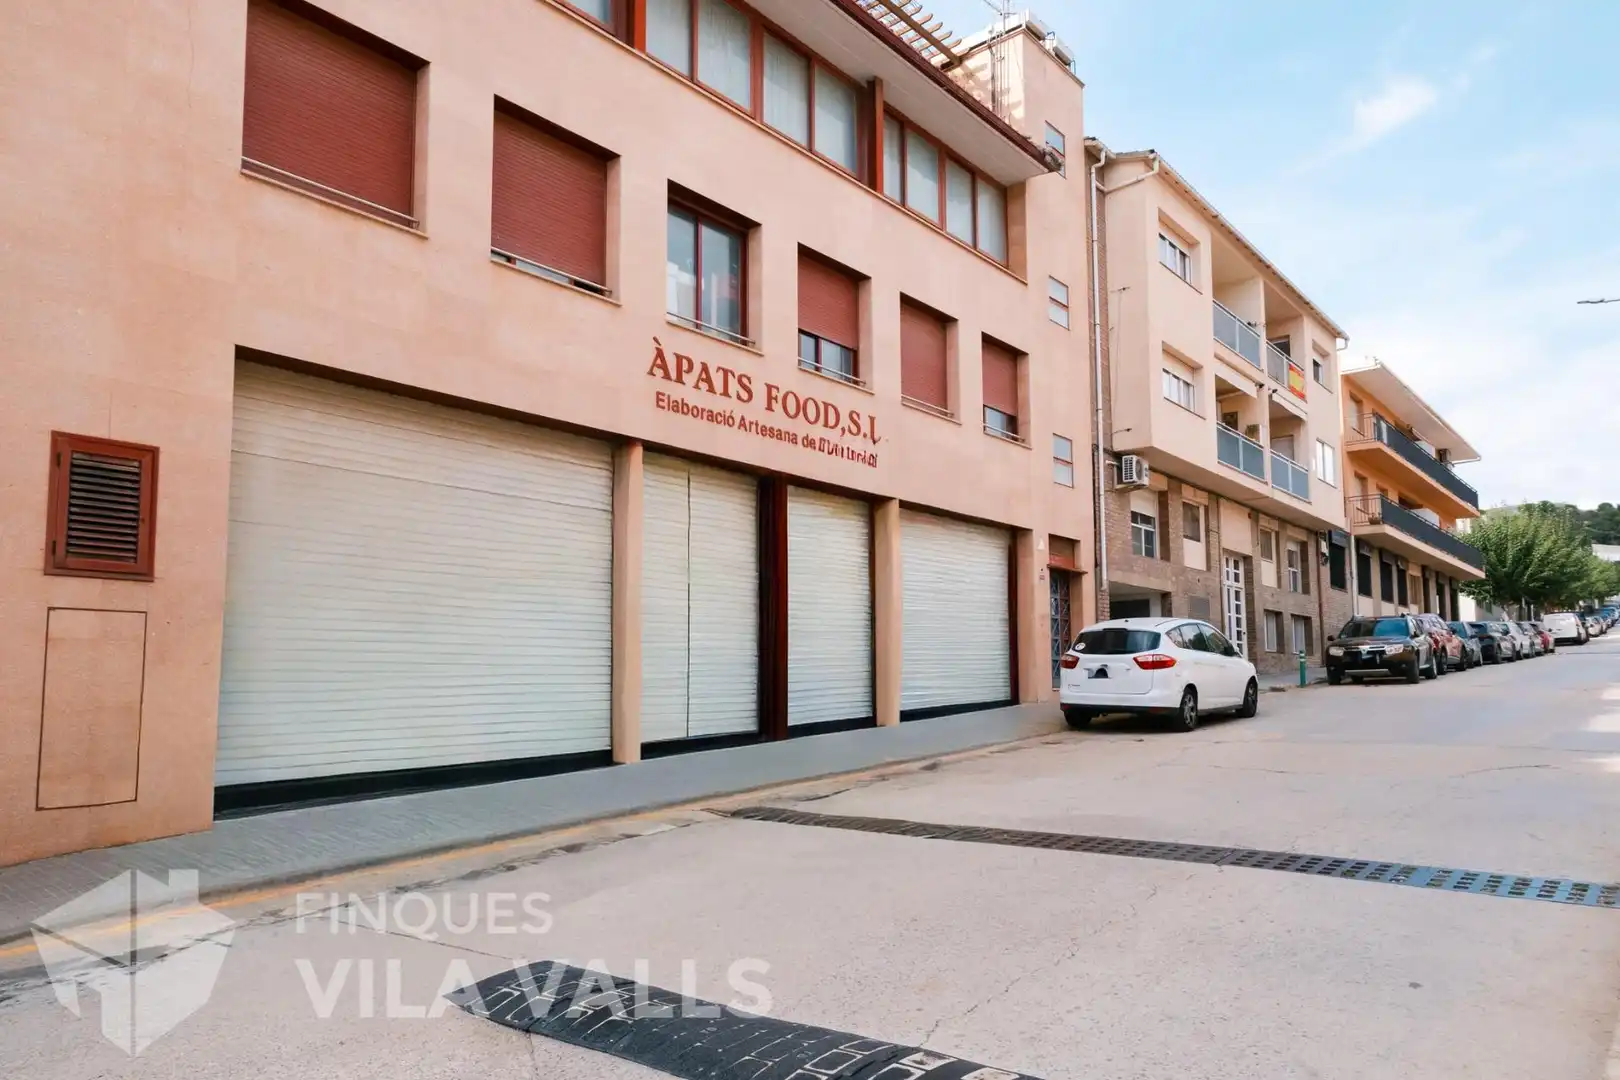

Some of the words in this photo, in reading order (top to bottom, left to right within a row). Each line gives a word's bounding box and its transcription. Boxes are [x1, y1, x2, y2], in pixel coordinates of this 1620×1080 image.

[647, 336, 754, 404] ÀPATS
[655, 390, 736, 428] Elaboració
[737, 414, 798, 445] Artesana
[801, 433, 816, 451] de
